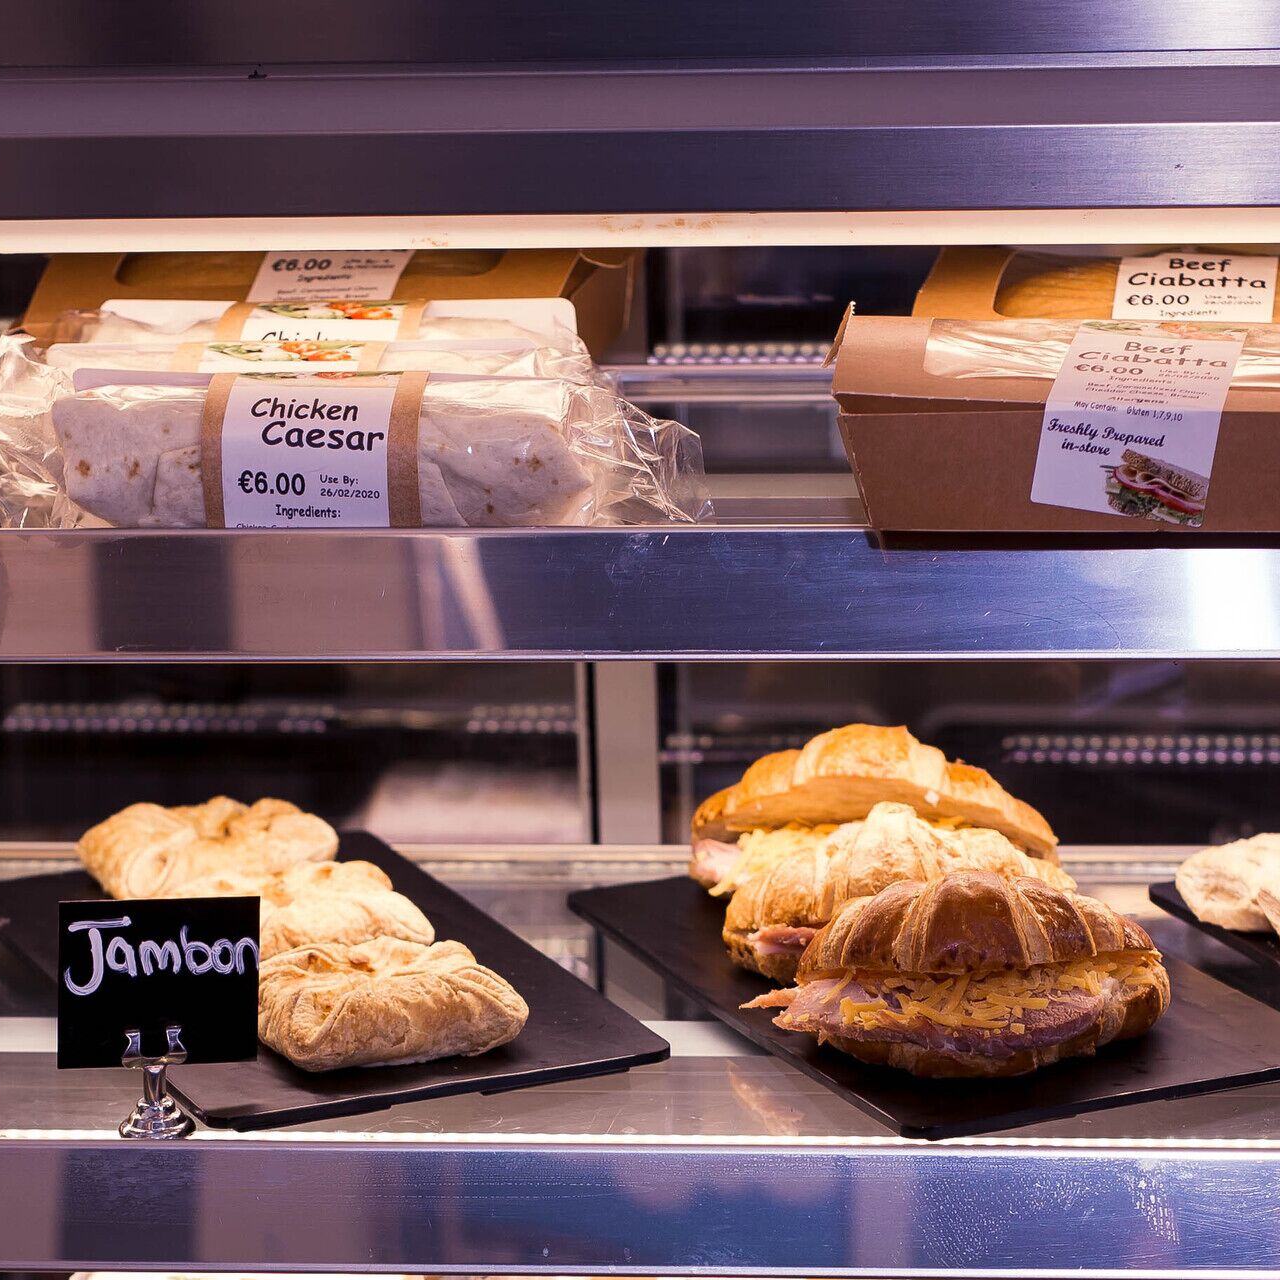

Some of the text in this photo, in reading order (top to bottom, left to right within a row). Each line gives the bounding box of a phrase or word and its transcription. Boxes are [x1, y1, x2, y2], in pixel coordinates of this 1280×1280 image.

[1169, 258, 1232, 272] Beef
[1127, 272, 1267, 289] Ciabatta
[1126, 293, 1191, 307] €6.00
[1124, 341, 1194, 355] Beef
[1078, 351, 1228, 368] Ciabatta
[250, 398, 359, 422] Chicken
[261, 421, 385, 451] Caesar
[1047, 418, 1165, 450] Freshly Prepared
[1061, 438, 1111, 456] in-store
[237, 470, 306, 496] €6.00
[320, 488, 380, 499] 26/02/2020
[275, 504, 341, 519] Ingredients:
[64, 916, 260, 995] Jambon
